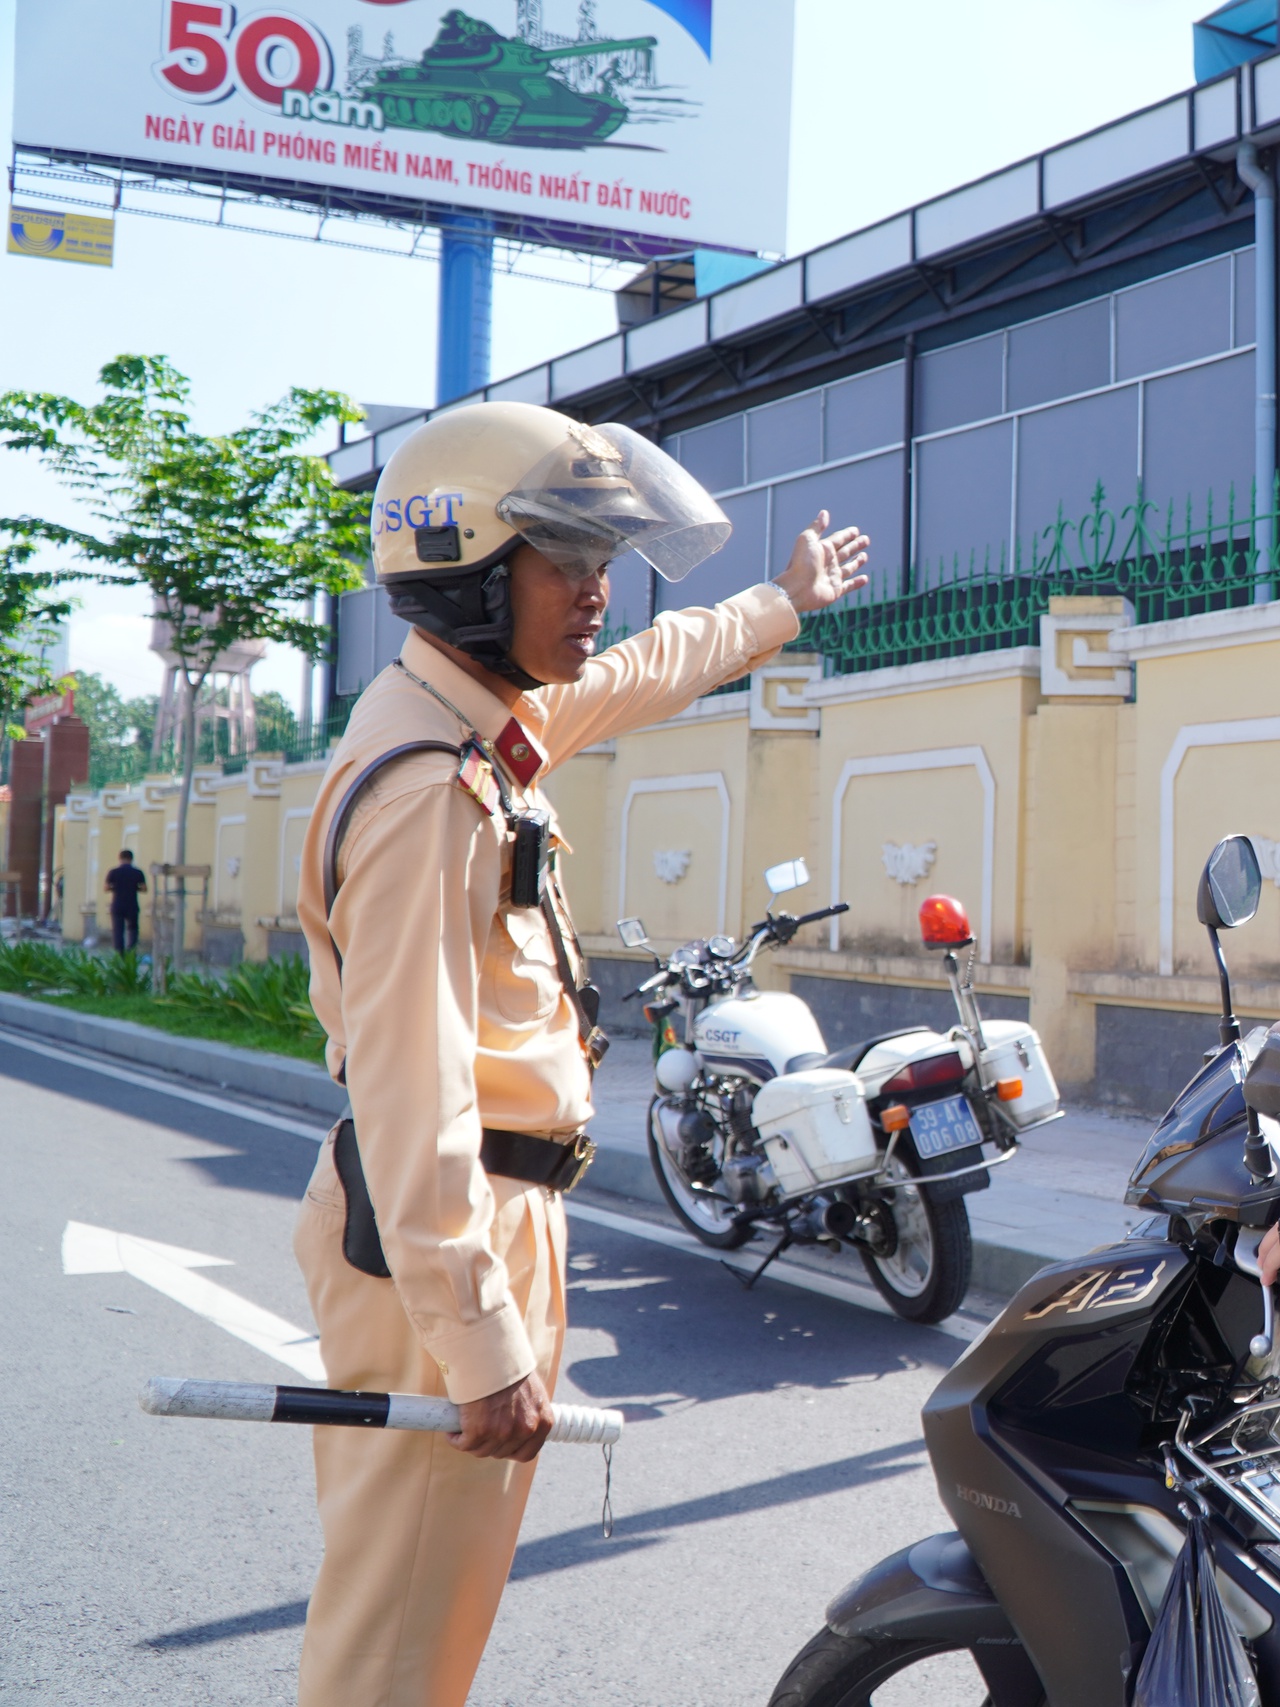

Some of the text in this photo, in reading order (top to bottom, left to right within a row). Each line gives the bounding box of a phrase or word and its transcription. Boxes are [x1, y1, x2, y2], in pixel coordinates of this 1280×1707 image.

[161, 1, 321, 107] 50
[282, 87, 384, 131] năm
[145, 113, 692, 220] NGÀY GIẢI PHÓNG MIỀN NAM, THỐNG NHẤT ĐẤT NƯỚC
[373, 493, 464, 536] CSGT
[705, 1029, 742, 1043] CSGT
[955, 1483, 1022, 1519] HONDA
